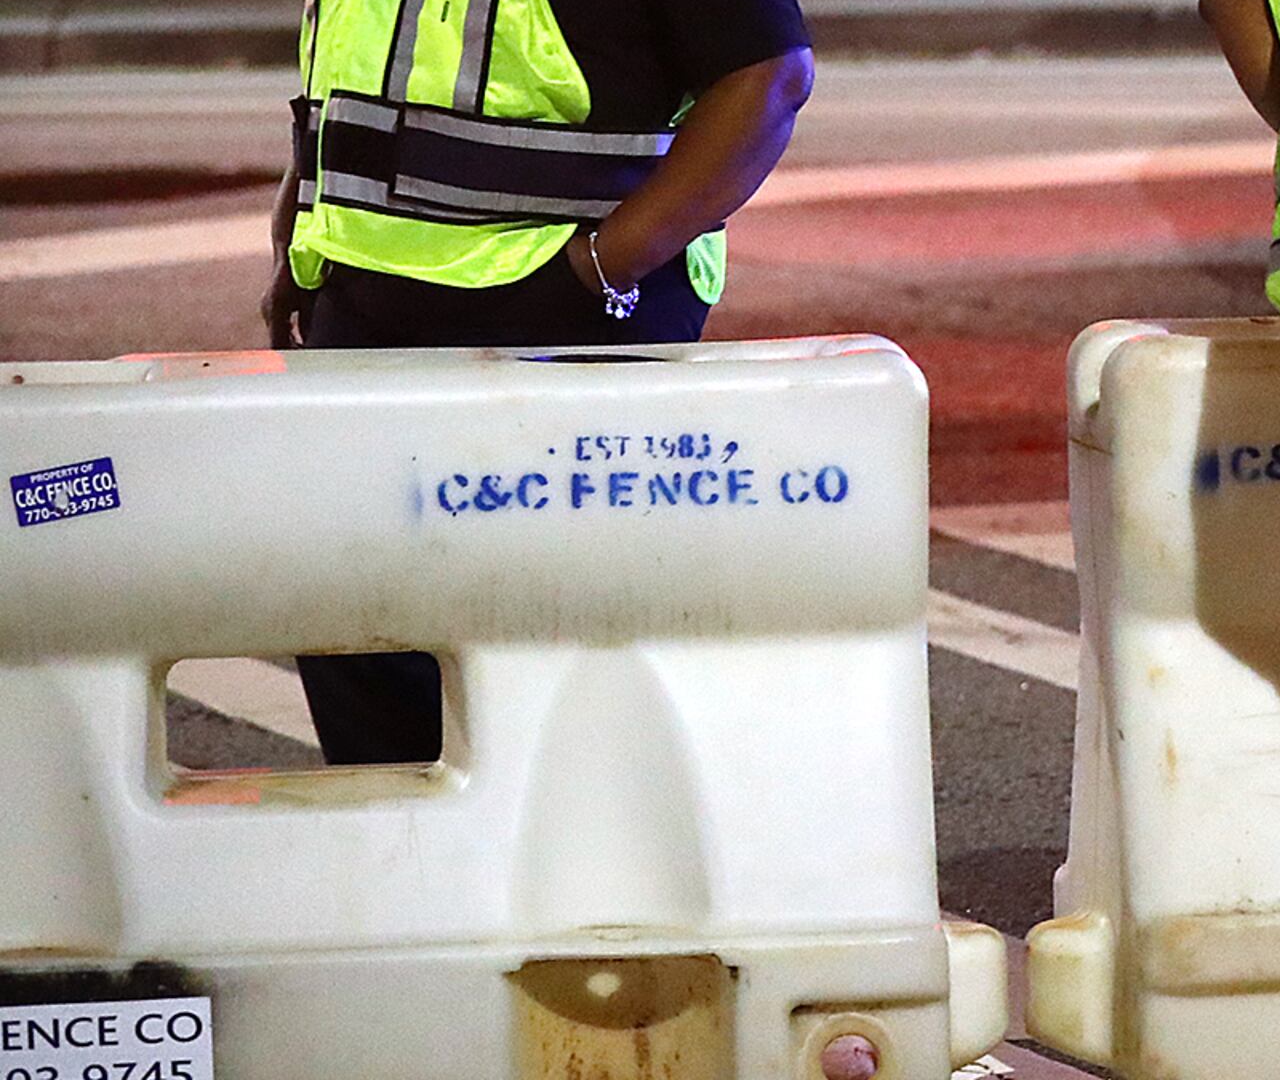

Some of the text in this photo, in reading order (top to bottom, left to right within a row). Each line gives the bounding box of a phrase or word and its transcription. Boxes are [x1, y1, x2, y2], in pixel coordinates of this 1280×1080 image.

[575, 435, 631, 461] EST
[30, 463, 94, 484] PROPERTY OF
[437, 464, 848, 512] C&C FENCE CO
[15, 486, 46, 508] C&C
[92, 472, 117, 492] CO.
[25, 494, 114, 523] 770-3-9745
[1, 1011, 203, 1051] ENCE CO
